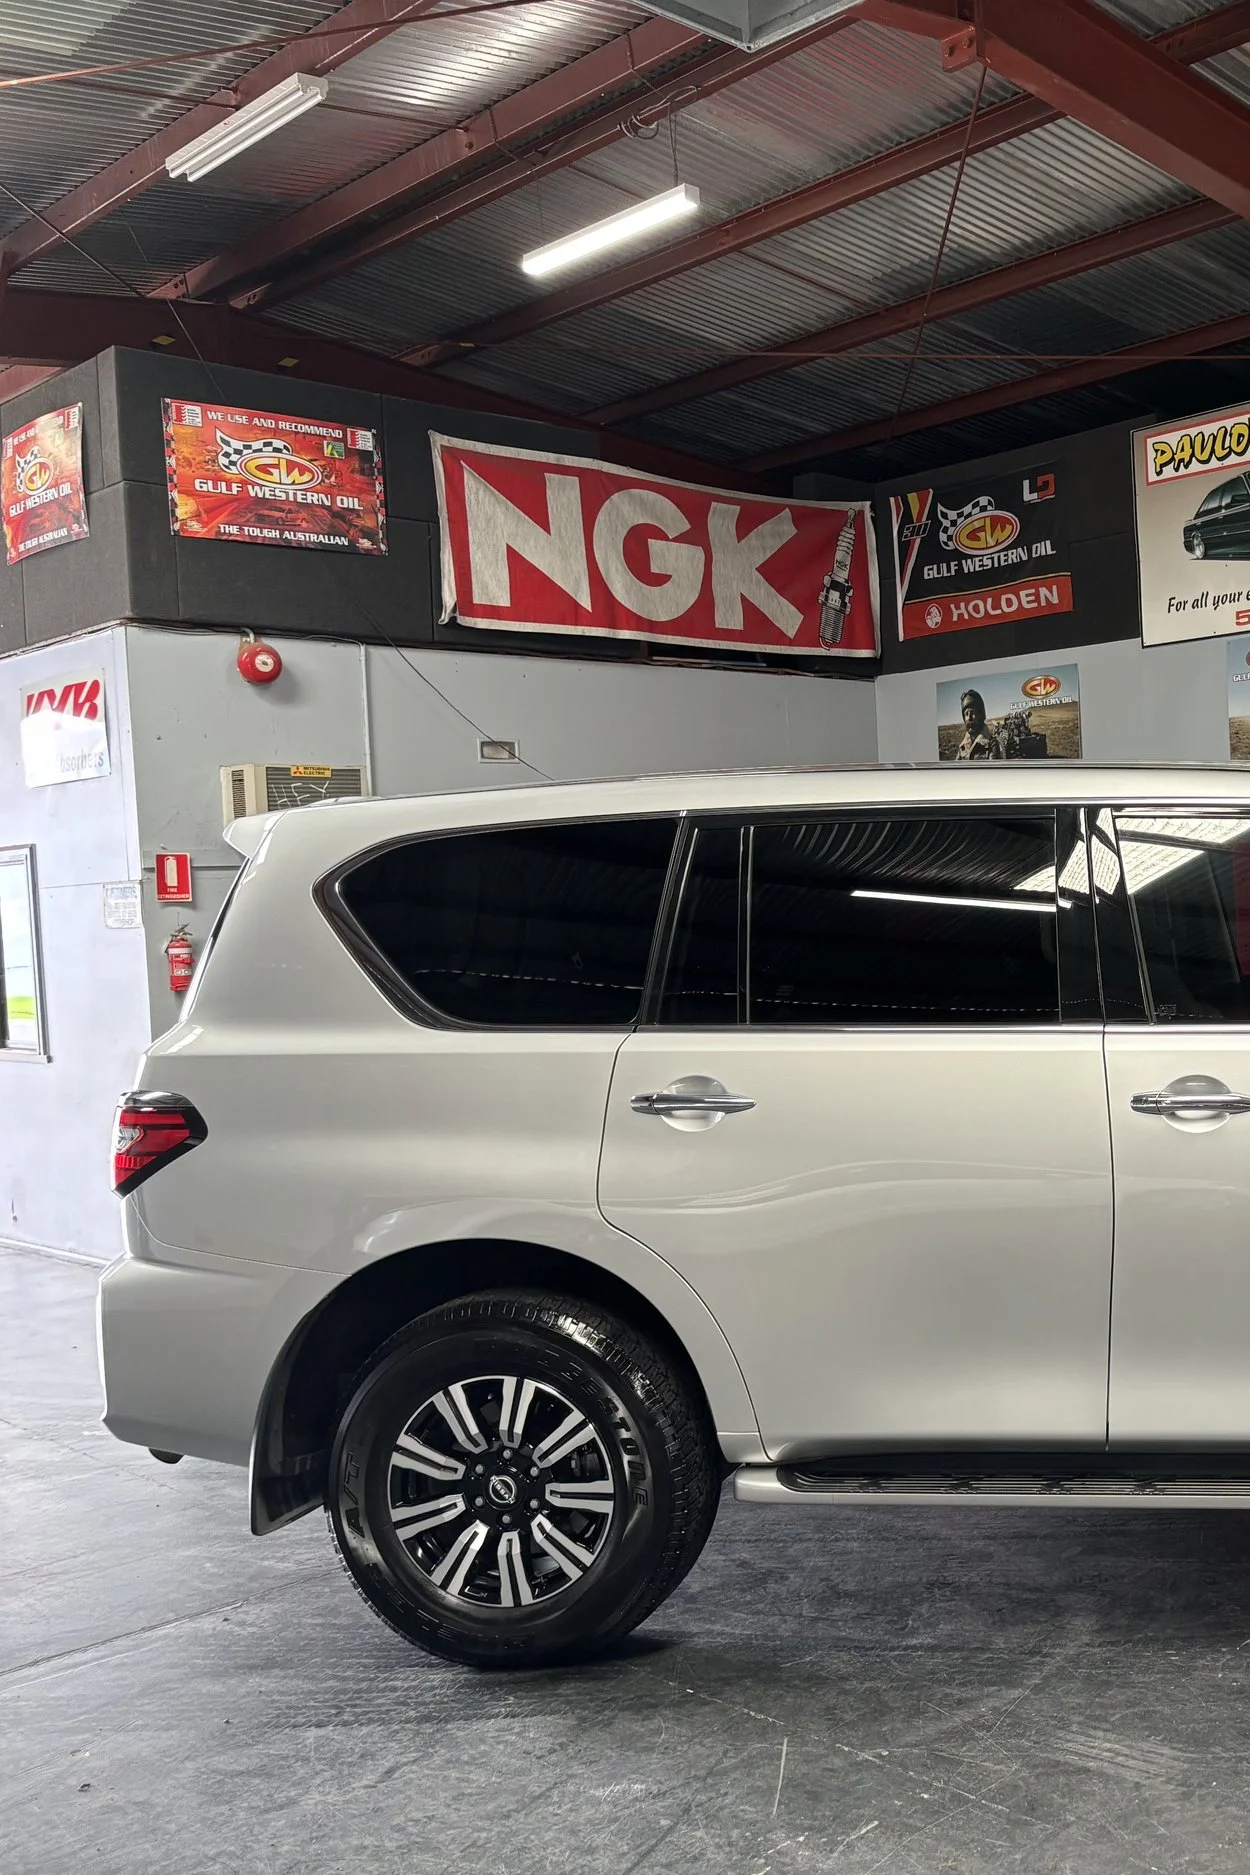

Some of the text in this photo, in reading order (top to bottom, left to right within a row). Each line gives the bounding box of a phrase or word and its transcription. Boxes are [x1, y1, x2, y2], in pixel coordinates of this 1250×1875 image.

[206, 410, 225, 421] WE
[227, 413, 250, 425] USE
[252, 417, 276, 429] AND
[278, 420, 343, 439] RECOMMEND
[243, 456, 314, 485] GW
[9, 481, 73, 518] GULF WESTERN OIL
[194, 478, 364, 510] GULF WESTERN OIL
[218, 523, 241, 536] THE
[244, 526, 280, 539] TOUGH
[284, 531, 349, 546] AUSTRALIAN
[957, 515, 1013, 550] GW
[459, 459, 805, 639] NGK
[923, 539, 1057, 581] GULF WESTERN OIL
[949, 584, 1060, 622] HOLDEN
[1166, 596, 1188, 614] For
[1191, 591, 1210, 611] all
[1212, 592, 1243, 611] your
[1010, 695, 1073, 710] GULF WESTERN OIL
[1024, 678, 1057, 697] GW
